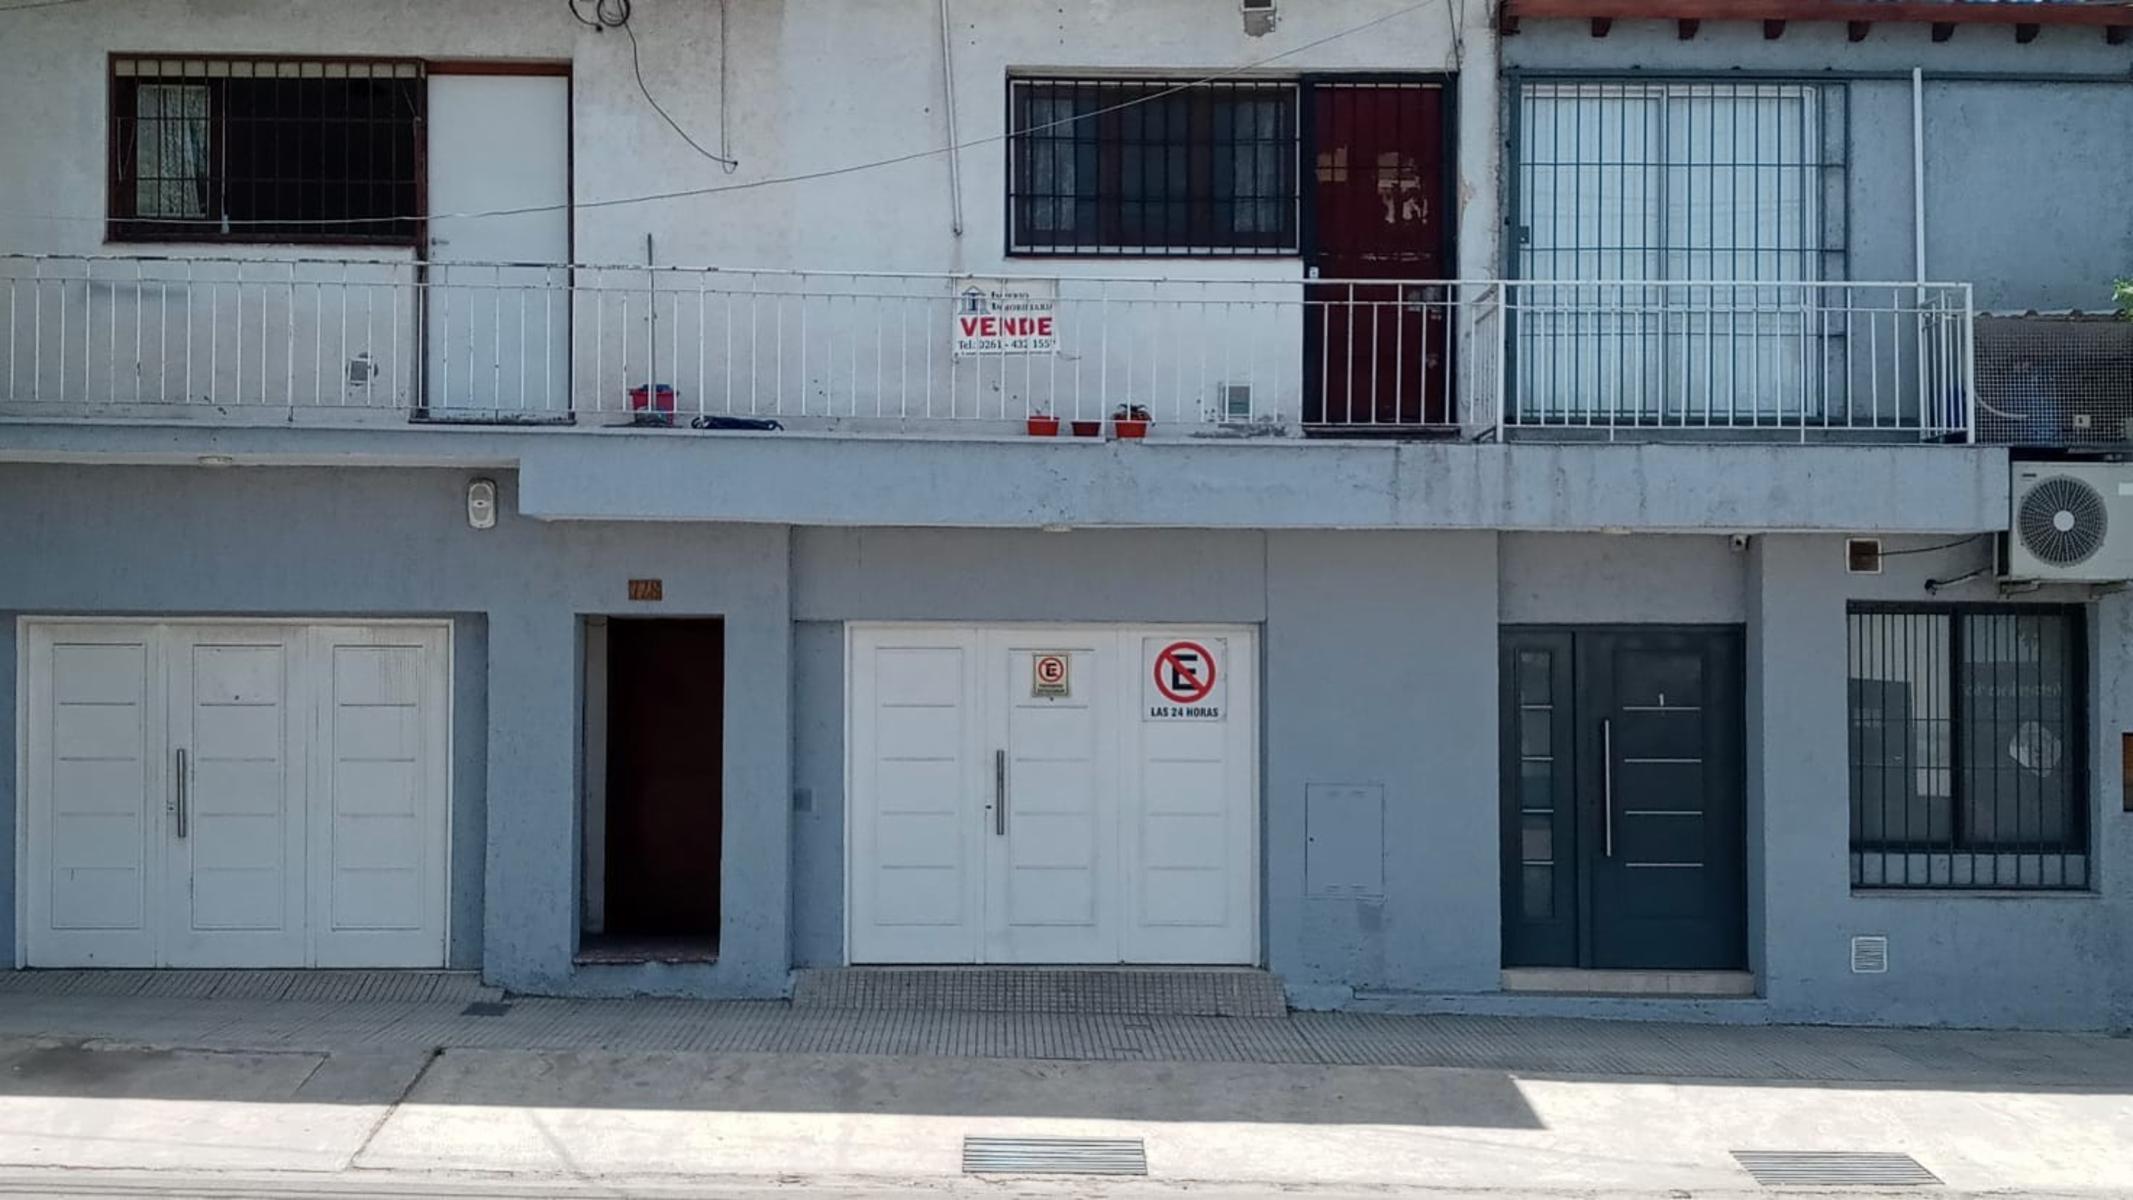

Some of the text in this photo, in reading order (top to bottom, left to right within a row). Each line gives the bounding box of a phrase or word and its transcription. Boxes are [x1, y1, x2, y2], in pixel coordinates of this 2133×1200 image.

[960, 316, 1053, 337] VENDE
[1046, 663, 1057, 677] E
[1172, 653, 1198, 690] E
[1151, 706, 1219, 718] LAS 24 HORAS
